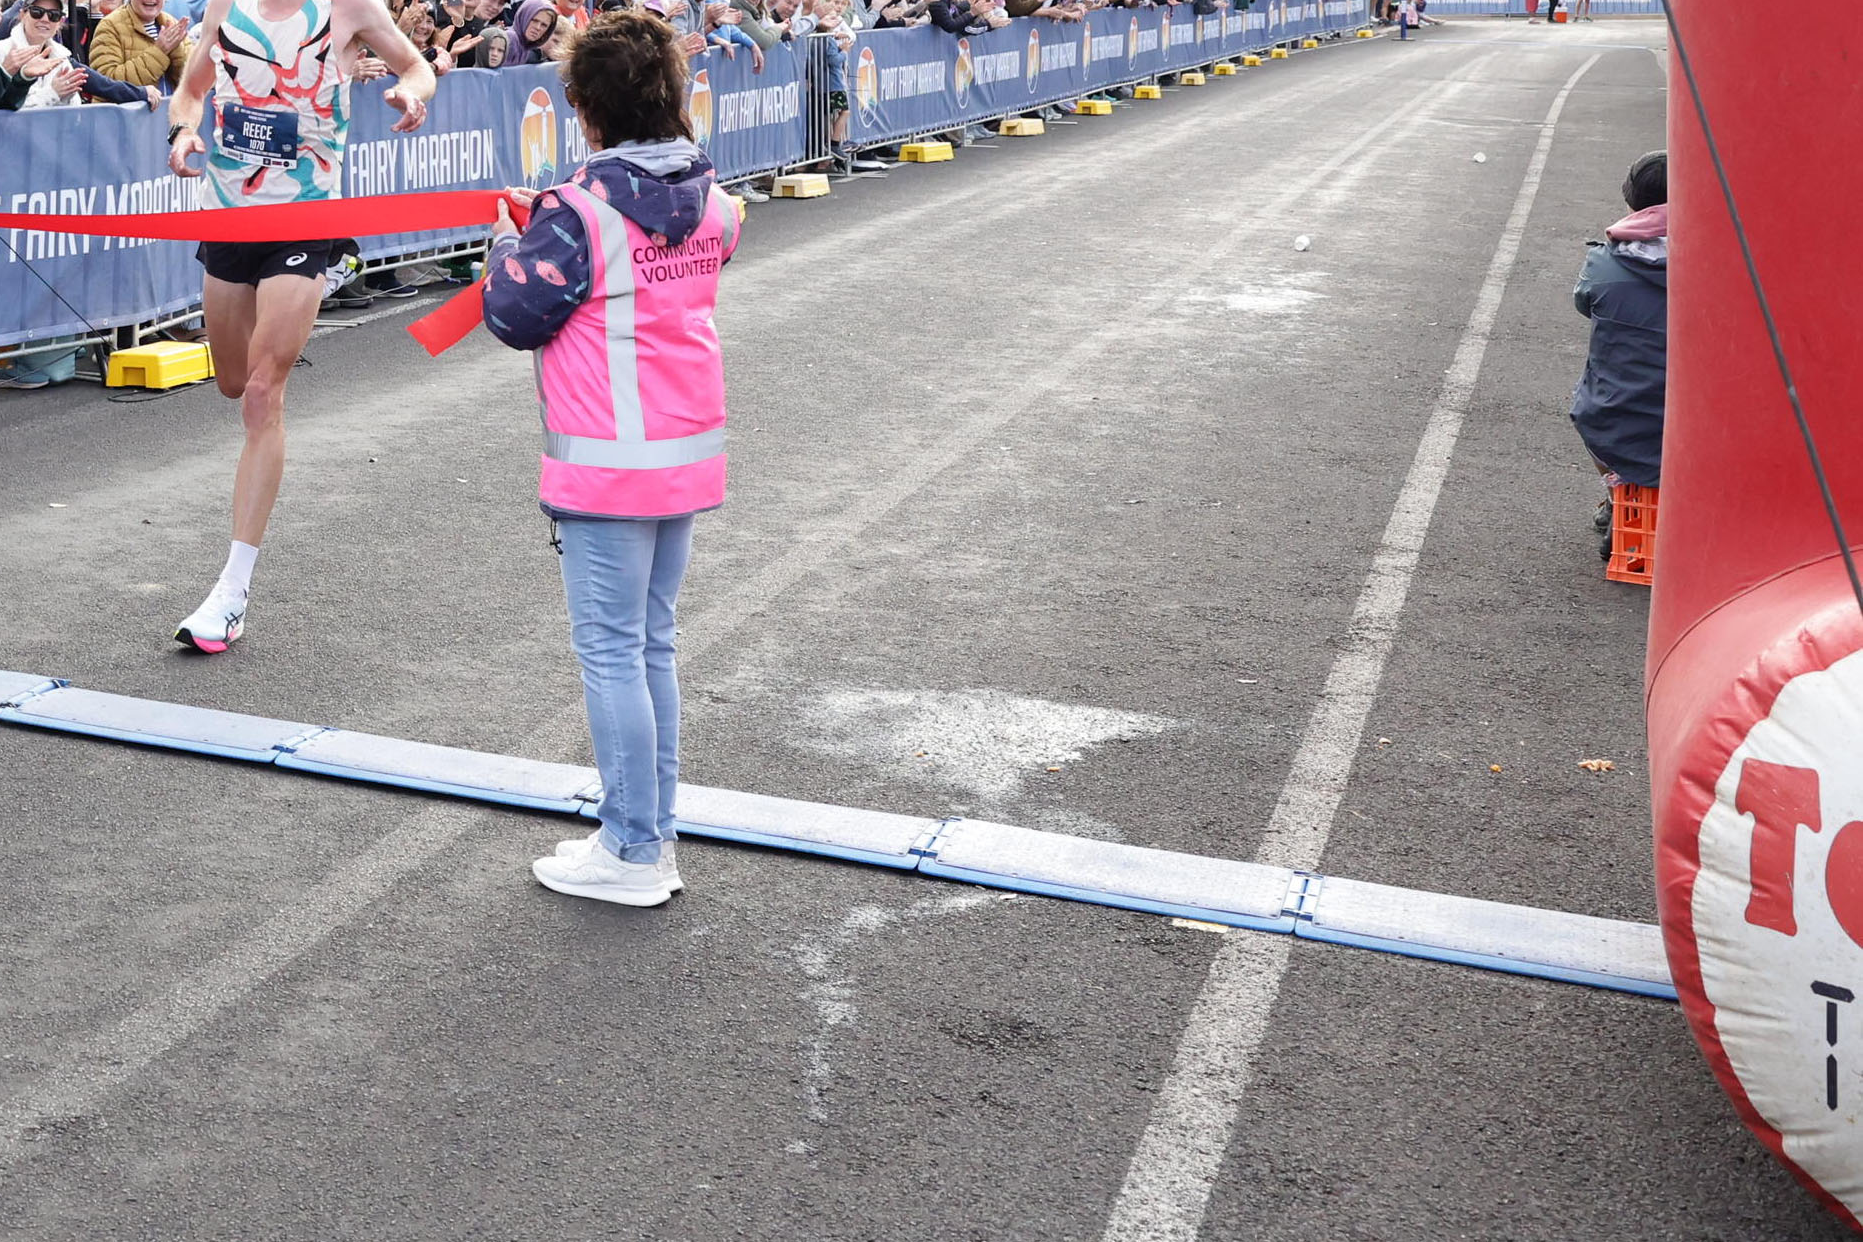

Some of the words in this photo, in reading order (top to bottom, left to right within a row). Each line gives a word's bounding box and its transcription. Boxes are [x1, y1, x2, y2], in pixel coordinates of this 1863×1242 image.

[242, 121, 273, 141] REECE
[719, 92, 739, 135] PORT
[249, 139, 266, 151] 1070
[565, 116, 590, 165] POR
[349, 139, 398, 198] FAIRY
[403, 128, 494, 191] MARATHON
[8, 186, 98, 263] FAIRY
[632, 236, 723, 264] COMMUNITY
[641, 257, 718, 284] VOLUNTEER
